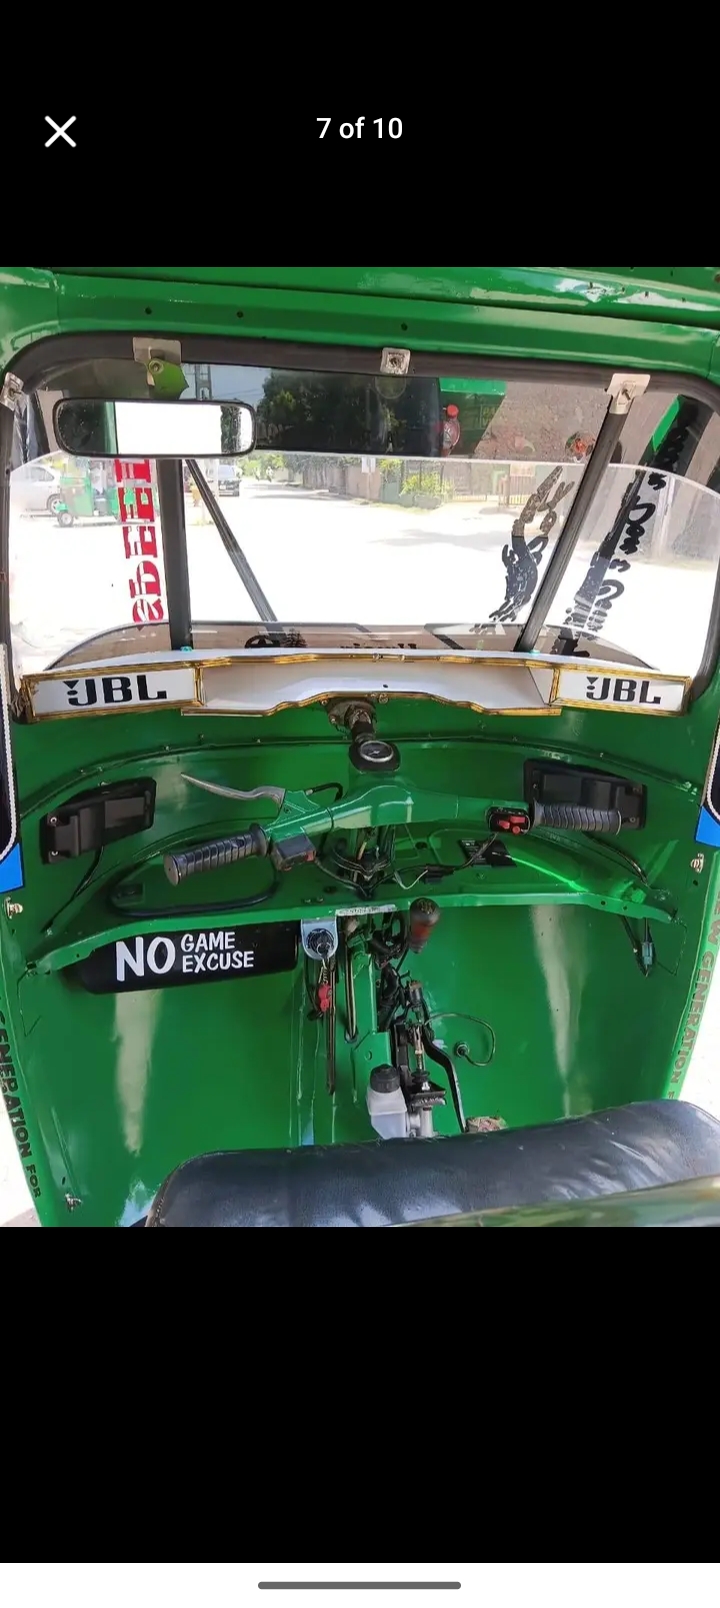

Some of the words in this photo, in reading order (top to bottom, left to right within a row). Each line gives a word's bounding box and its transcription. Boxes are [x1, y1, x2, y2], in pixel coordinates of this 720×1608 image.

[63, 675, 168, 706] JBL
[586, 677, 661, 704] JBL
[180, 931, 236, 953] GAME
[116, 936, 176, 982] NO
[182, 951, 254, 973] EXCUSE
[669, 950, 715, 1084] GENERATION
[26, 1164, 41, 1198] FOR
